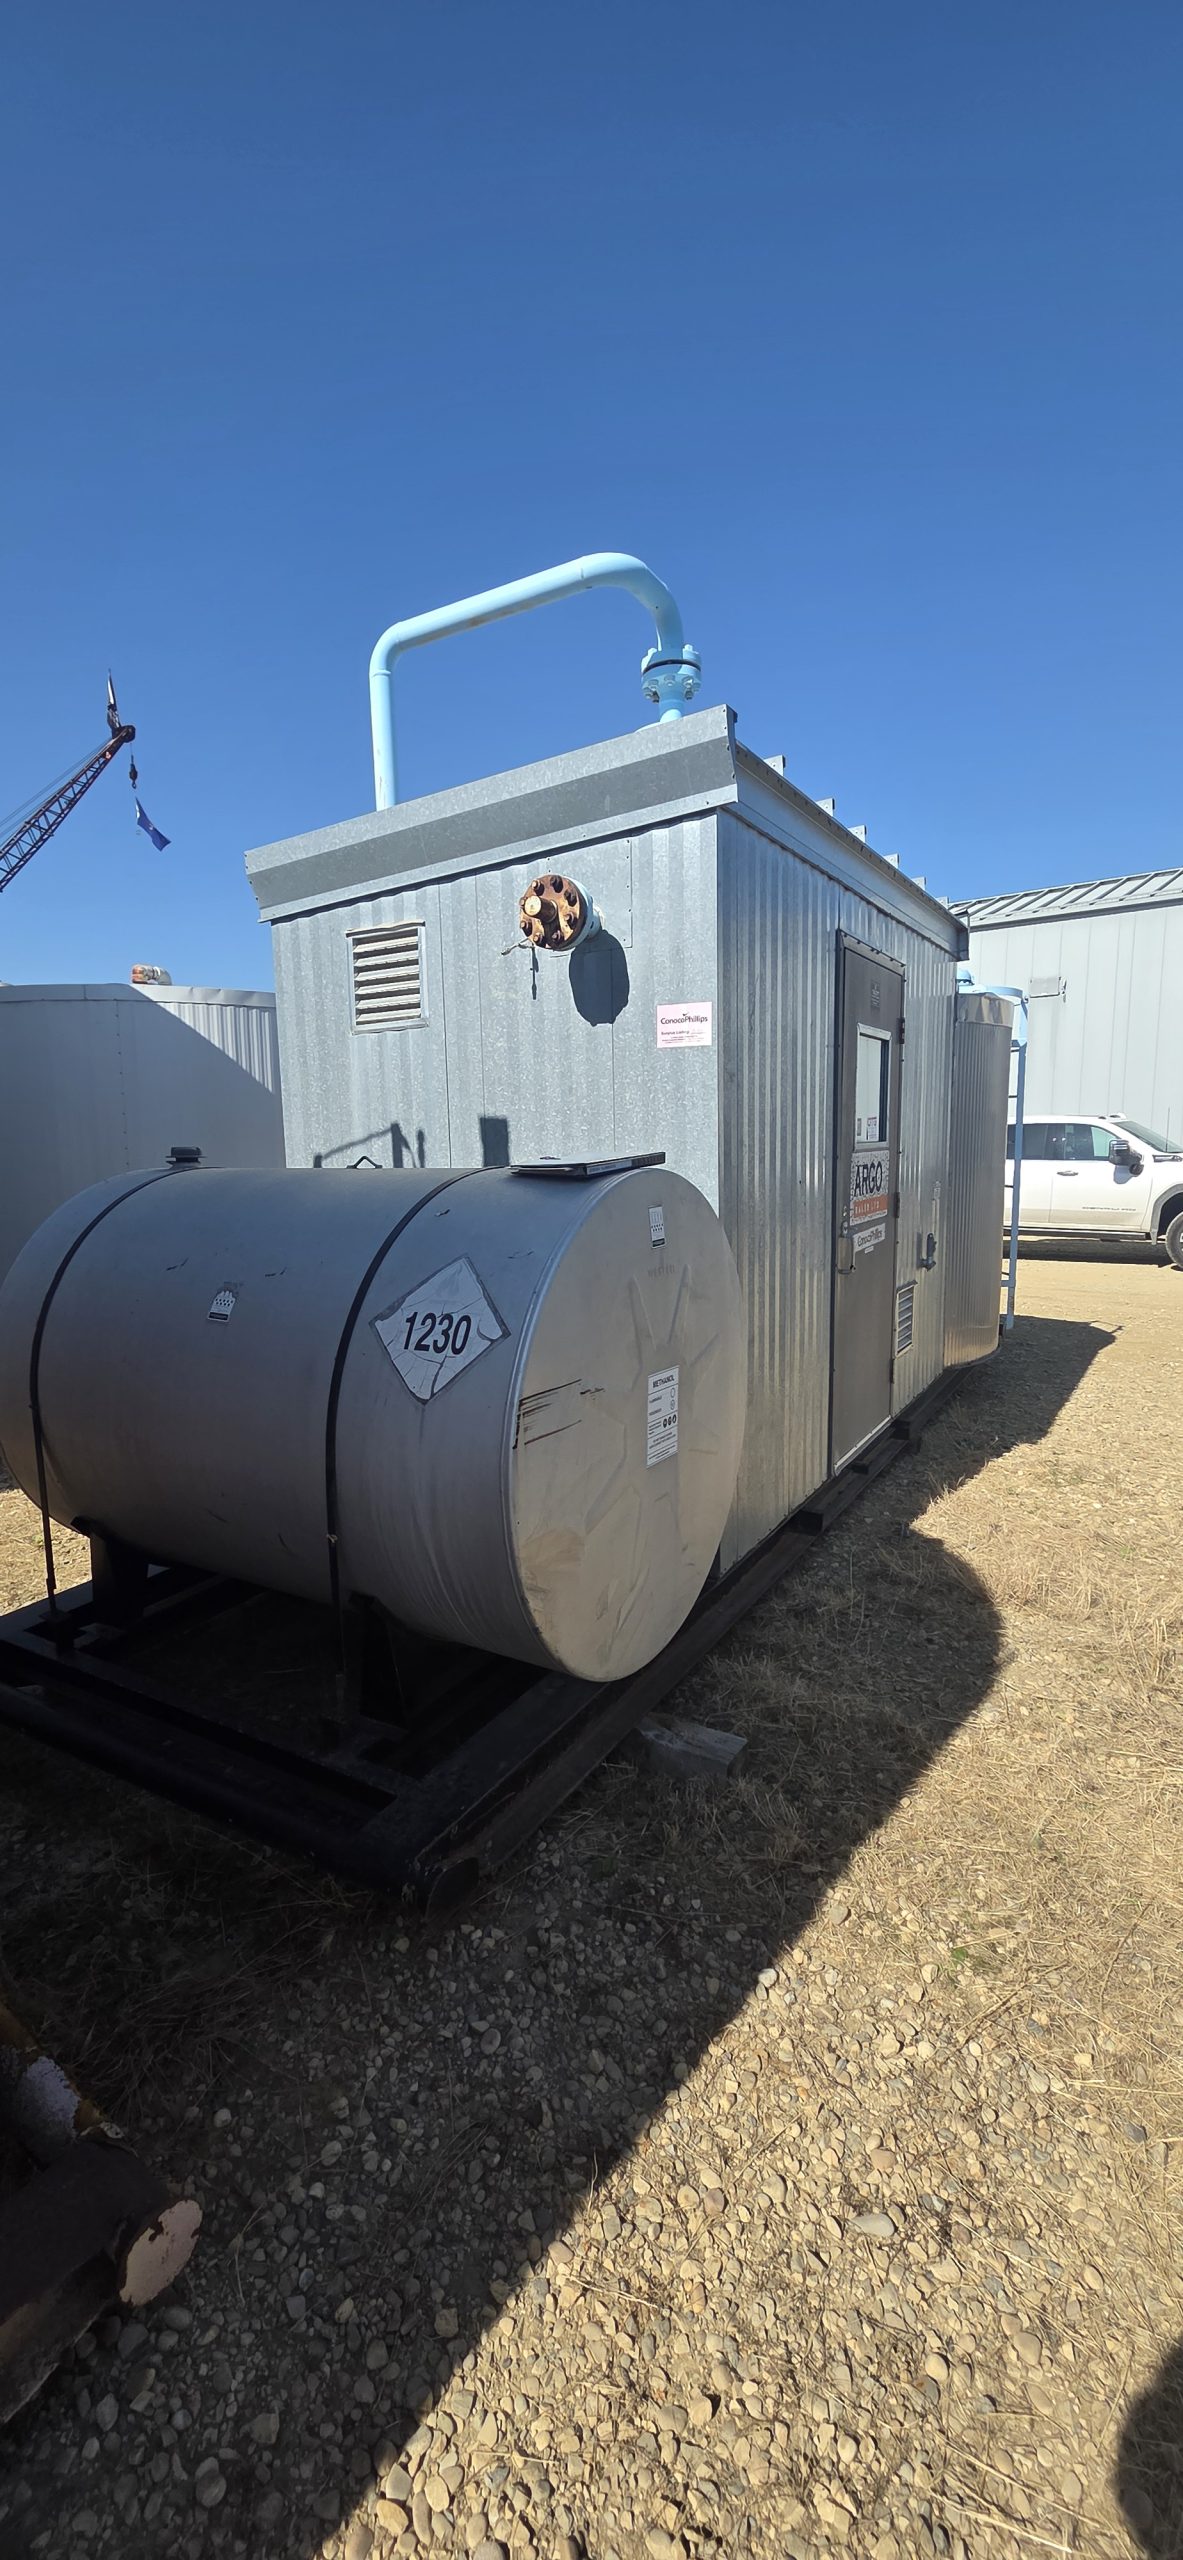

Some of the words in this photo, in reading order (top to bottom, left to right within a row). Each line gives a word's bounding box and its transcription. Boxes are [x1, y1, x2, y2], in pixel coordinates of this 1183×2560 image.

[660, 1015, 708, 1025] ConocoPhillips
[853, 1160, 883, 1198] ARGO
[403, 1311, 472, 1355] 1230
[652, 1374, 675, 1388] METHANOL
